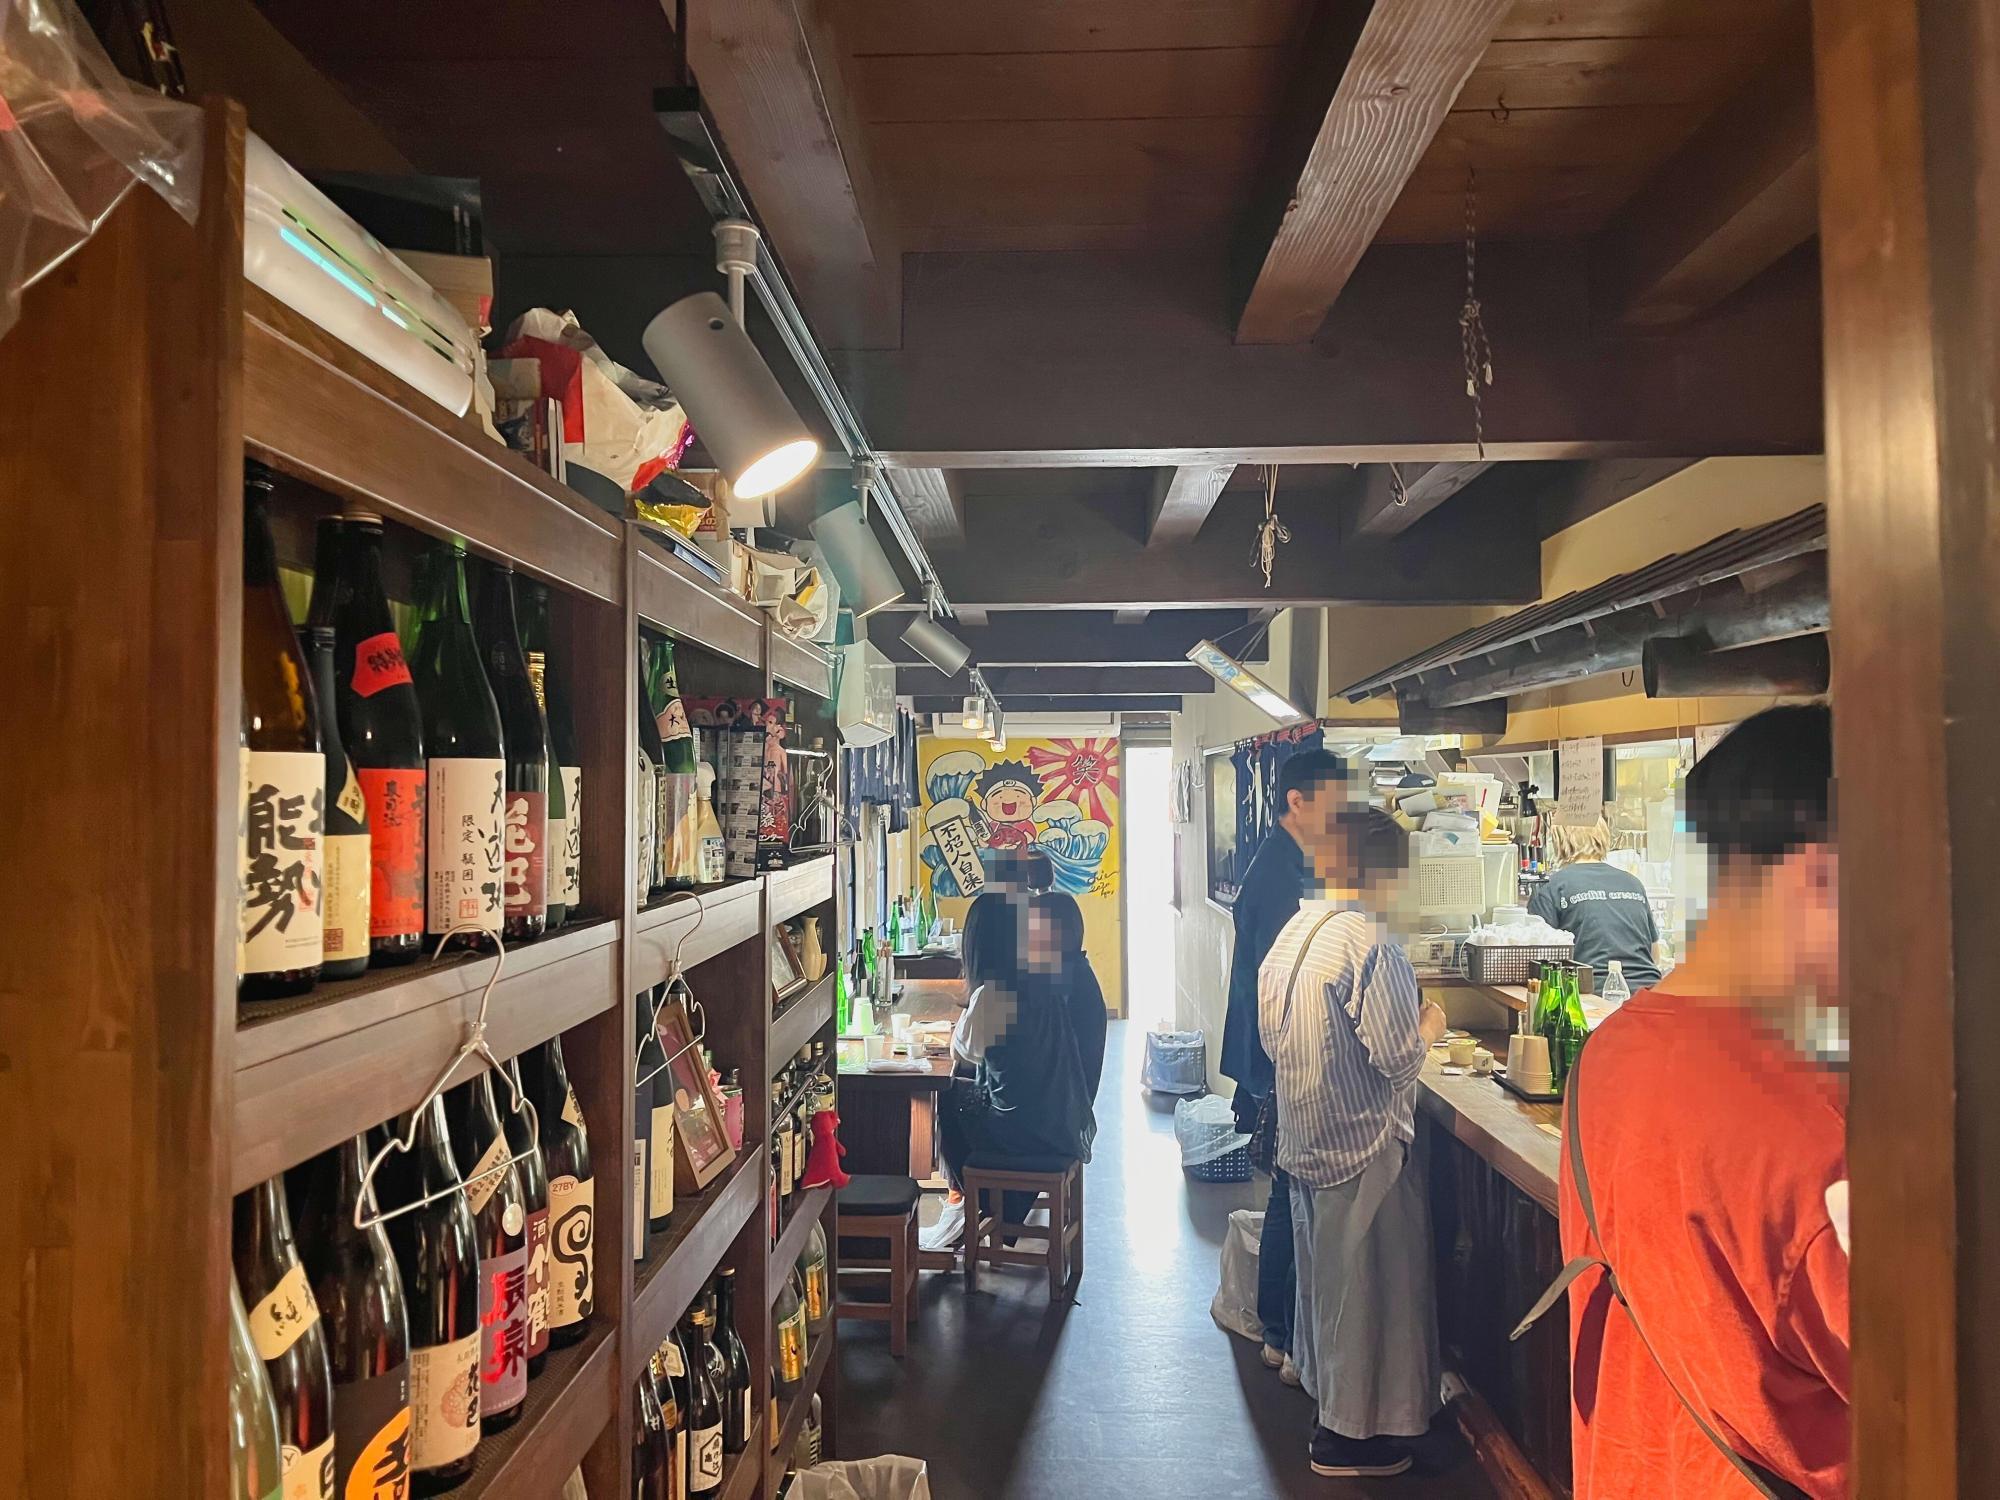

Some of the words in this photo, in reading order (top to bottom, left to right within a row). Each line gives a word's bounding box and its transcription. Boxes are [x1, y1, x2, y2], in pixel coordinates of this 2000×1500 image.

[1071, 754, 1100, 785] 笑
[246, 783, 316, 944] 能勢
[551, 1181, 575, 1193] 27BY
